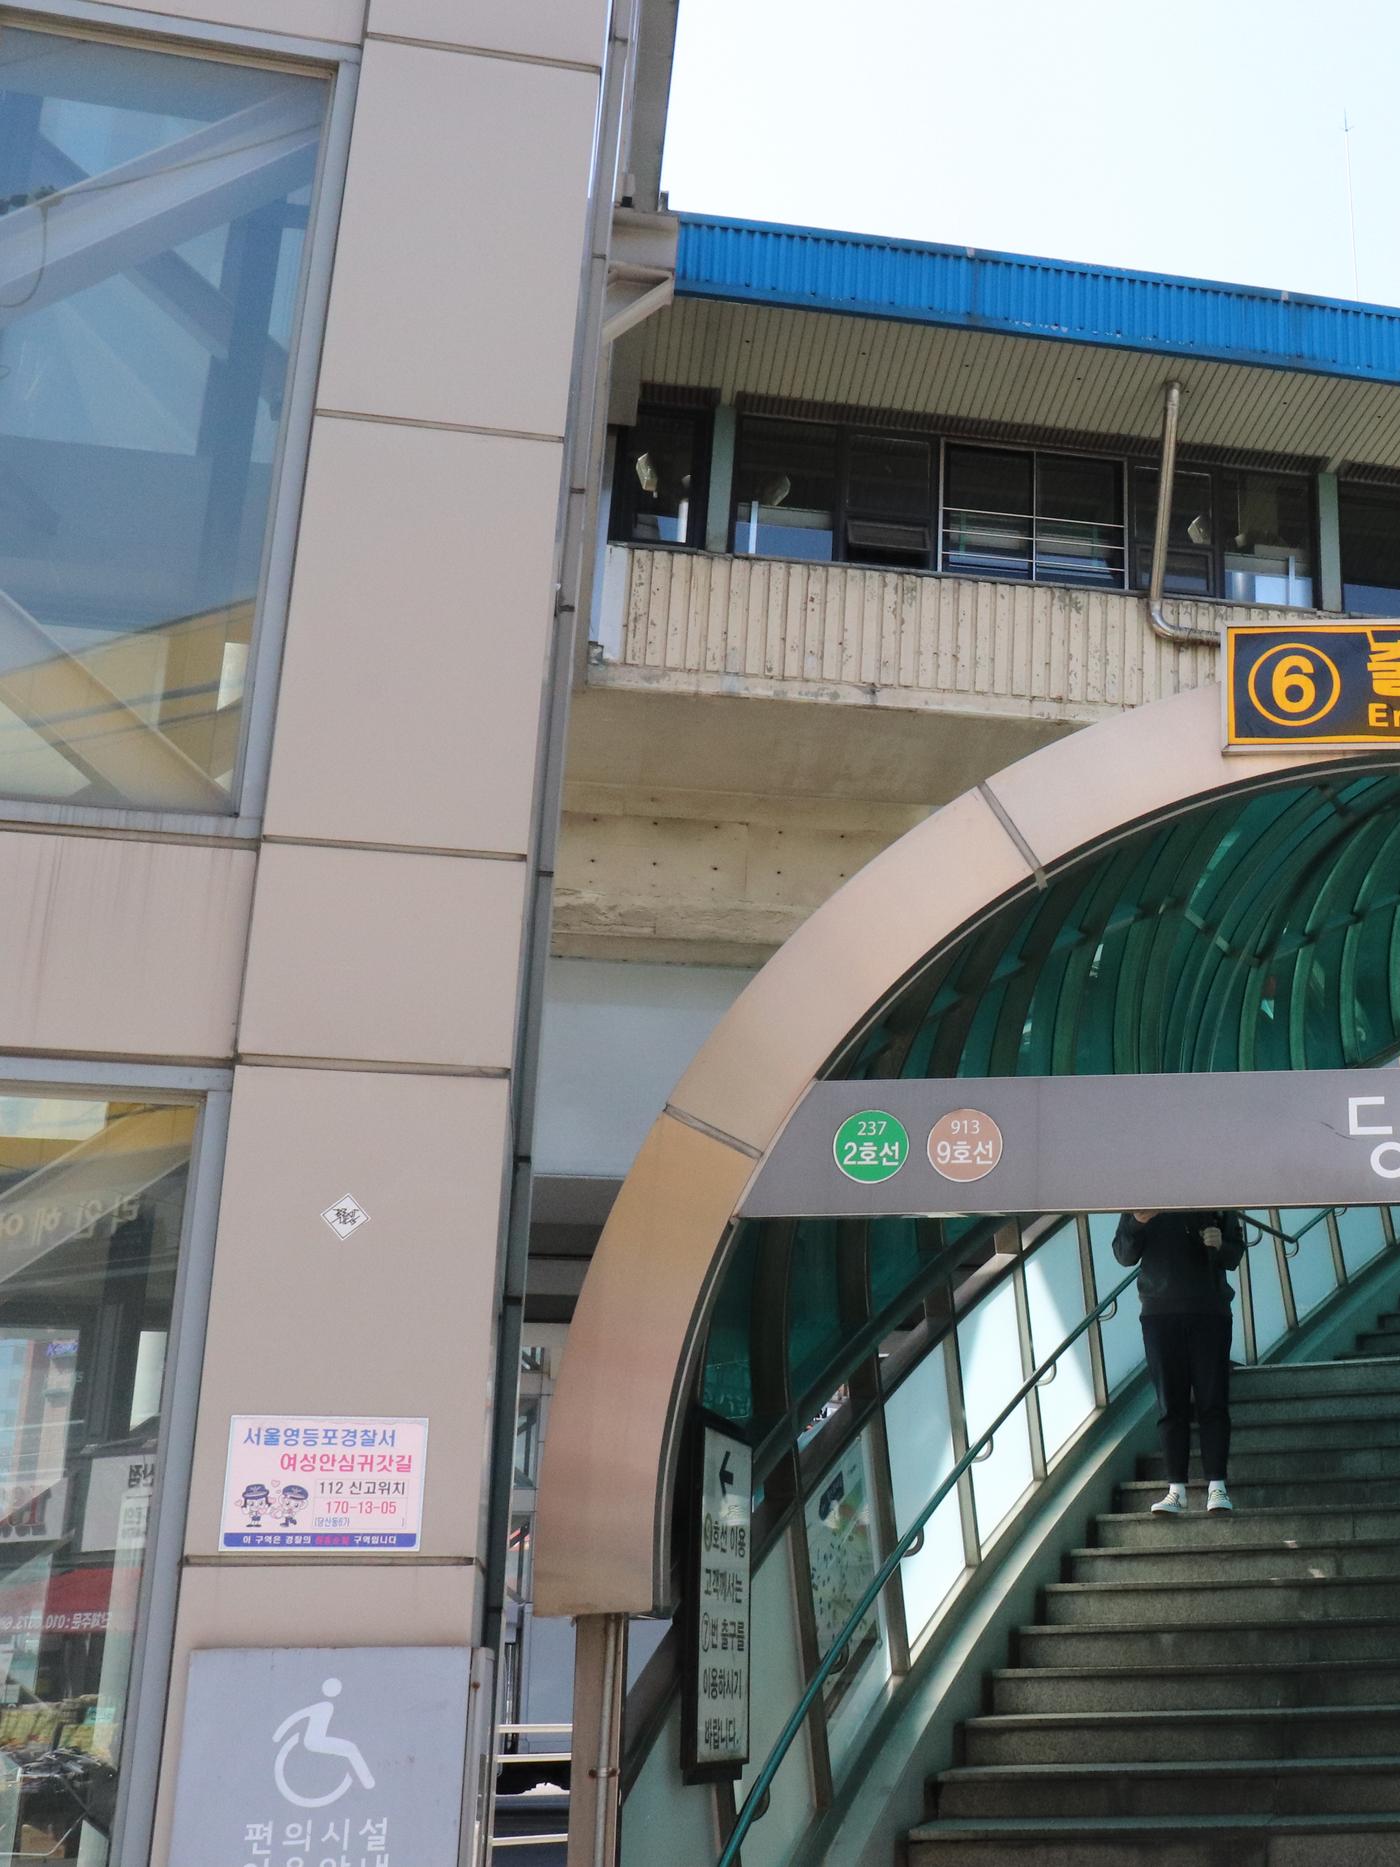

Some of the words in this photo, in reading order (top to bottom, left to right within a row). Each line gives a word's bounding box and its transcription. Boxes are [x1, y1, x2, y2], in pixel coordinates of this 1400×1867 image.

[857, 1121, 887, 1136] 237
[951, 1120, 980, 1135] 913
[843, 1141, 899, 1166] 2호선
[937, 1140, 993, 1164] 9호선
[243, 1427, 396, 1447] 서울영등포경찰서
[280, 1453, 413, 1473] 여성안심귀갓길
[320, 1481, 343, 1494] 112
[349, 1481, 405, 1495] 신고위치
[326, 1501, 396, 1514] 170-13-05
[242, 1535, 250, 1544] 이
[255, 1535, 281, 1544] 구역은
[285, 1535, 312, 1544] 경찰의
[353, 1535, 397, 1544] 구역입니다
[730, 1526, 746, 1558] 이용
[704, 1568, 743, 1604] 고객께서는
[721, 1618, 745, 1652] 출구를
[703, 1667, 742, 1700] 이용하시기
[244, 1817, 388, 1855] 편의시설
